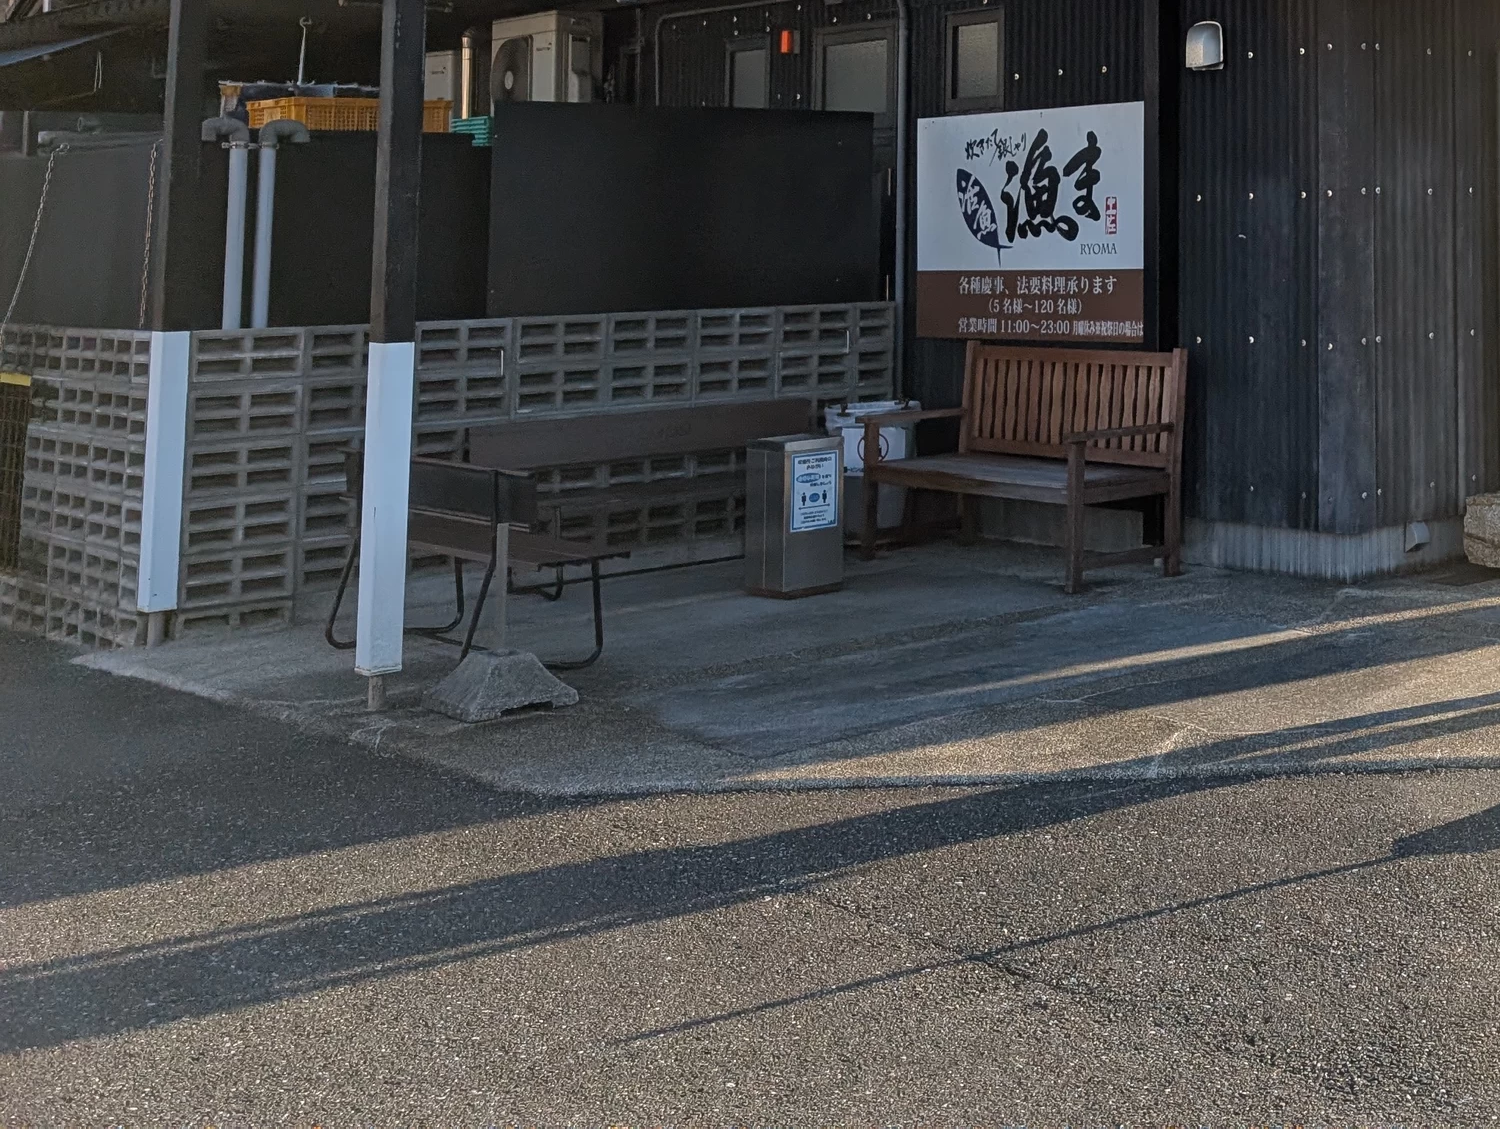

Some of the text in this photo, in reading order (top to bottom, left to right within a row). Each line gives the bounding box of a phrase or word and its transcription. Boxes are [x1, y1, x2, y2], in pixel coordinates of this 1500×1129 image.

[1001, 128, 1102, 243] 漁ま
[1080, 243, 1117, 255] RYOMA
[959, 276, 1118, 295] 各種慶事、法要料理承ります
